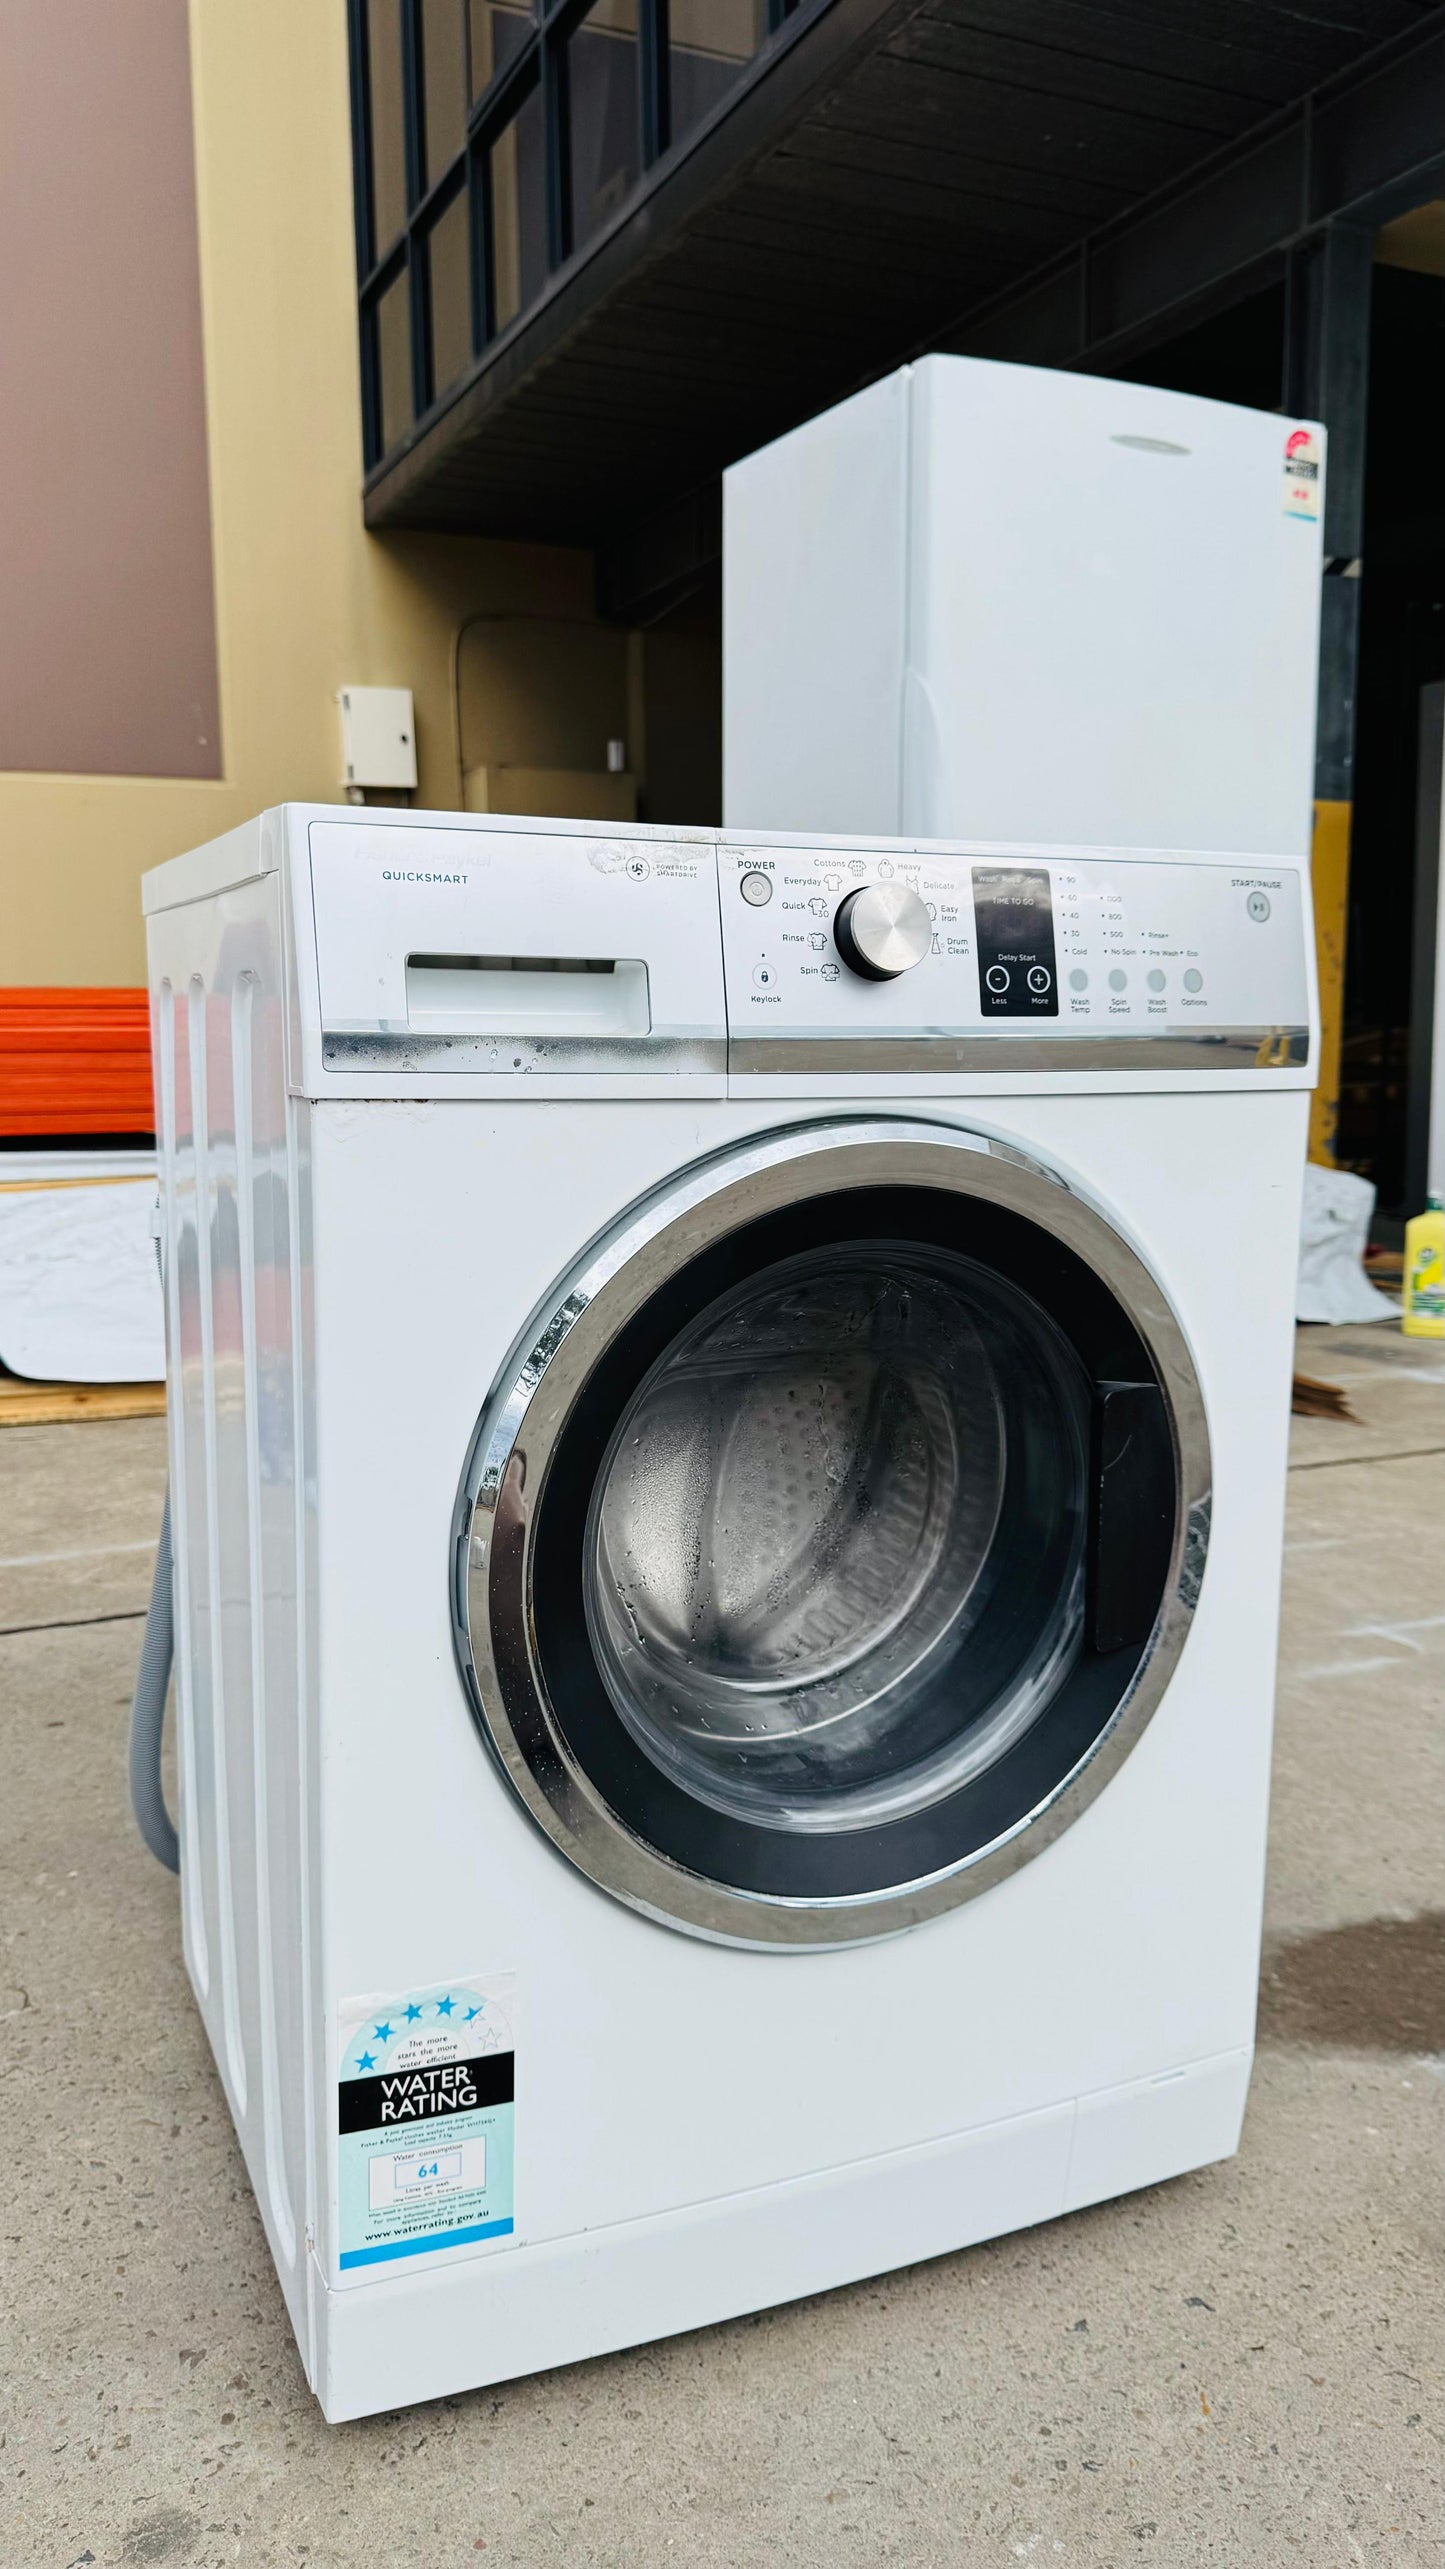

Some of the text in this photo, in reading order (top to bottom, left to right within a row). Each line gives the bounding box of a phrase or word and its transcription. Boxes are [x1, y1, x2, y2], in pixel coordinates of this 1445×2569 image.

[737, 860, 776, 870] POWER
[813, 859, 846, 868] Cottons
[897, 862, 922, 872] Heavy
[382, 870, 469, 885] QUICKSMART
[784, 877, 822, 886] Everyday
[923, 881, 955, 890] Delicate
[1231, 879, 1282, 889] START/PAUSE
[781, 901, 806, 911] Quick
[992, 897, 1010, 905] TIME
[1022, 898, 1035, 906] GO
[940, 905, 959, 915] Easy
[941, 914, 957, 923] Iron
[782, 933, 805, 943] Rinse
[946, 937, 969, 946] Drum
[947, 946, 970, 955] Clean
[1071, 948, 1088, 956] Cold
[1110, 948, 1137, 957] No Spin
[998, 954, 1037, 962] Delay Start
[800, 966, 819, 976] Spin
[751, 995, 782, 1004] Keylock
[991, 997, 1008, 1005] Less
[1031, 997, 1049, 1005] More
[1070, 998, 1090, 1006] Wash
[1111, 998, 1127, 1006] Spin
[1147, 998, 1167, 1006] Wash
[1181, 998, 1208, 1007] Options
[1071, 1006, 1091, 1014] Temp
[1108, 1006, 1131, 1014] Speed
[1147, 1006, 1168, 1014] Boost
[409, 2036, 448, 2048] The more
[397, 2043, 459, 2060] stars the more
[399, 2054, 456, 2069] water efficient
[381, 2066, 471, 2099] WATER
[381, 2085, 478, 2122] RATING
[393, 2144, 464, 2162] Water consumption
[418, 2162, 439, 2178] 64
[364, 2210, 490, 2241] www.waterrating.gov.au
